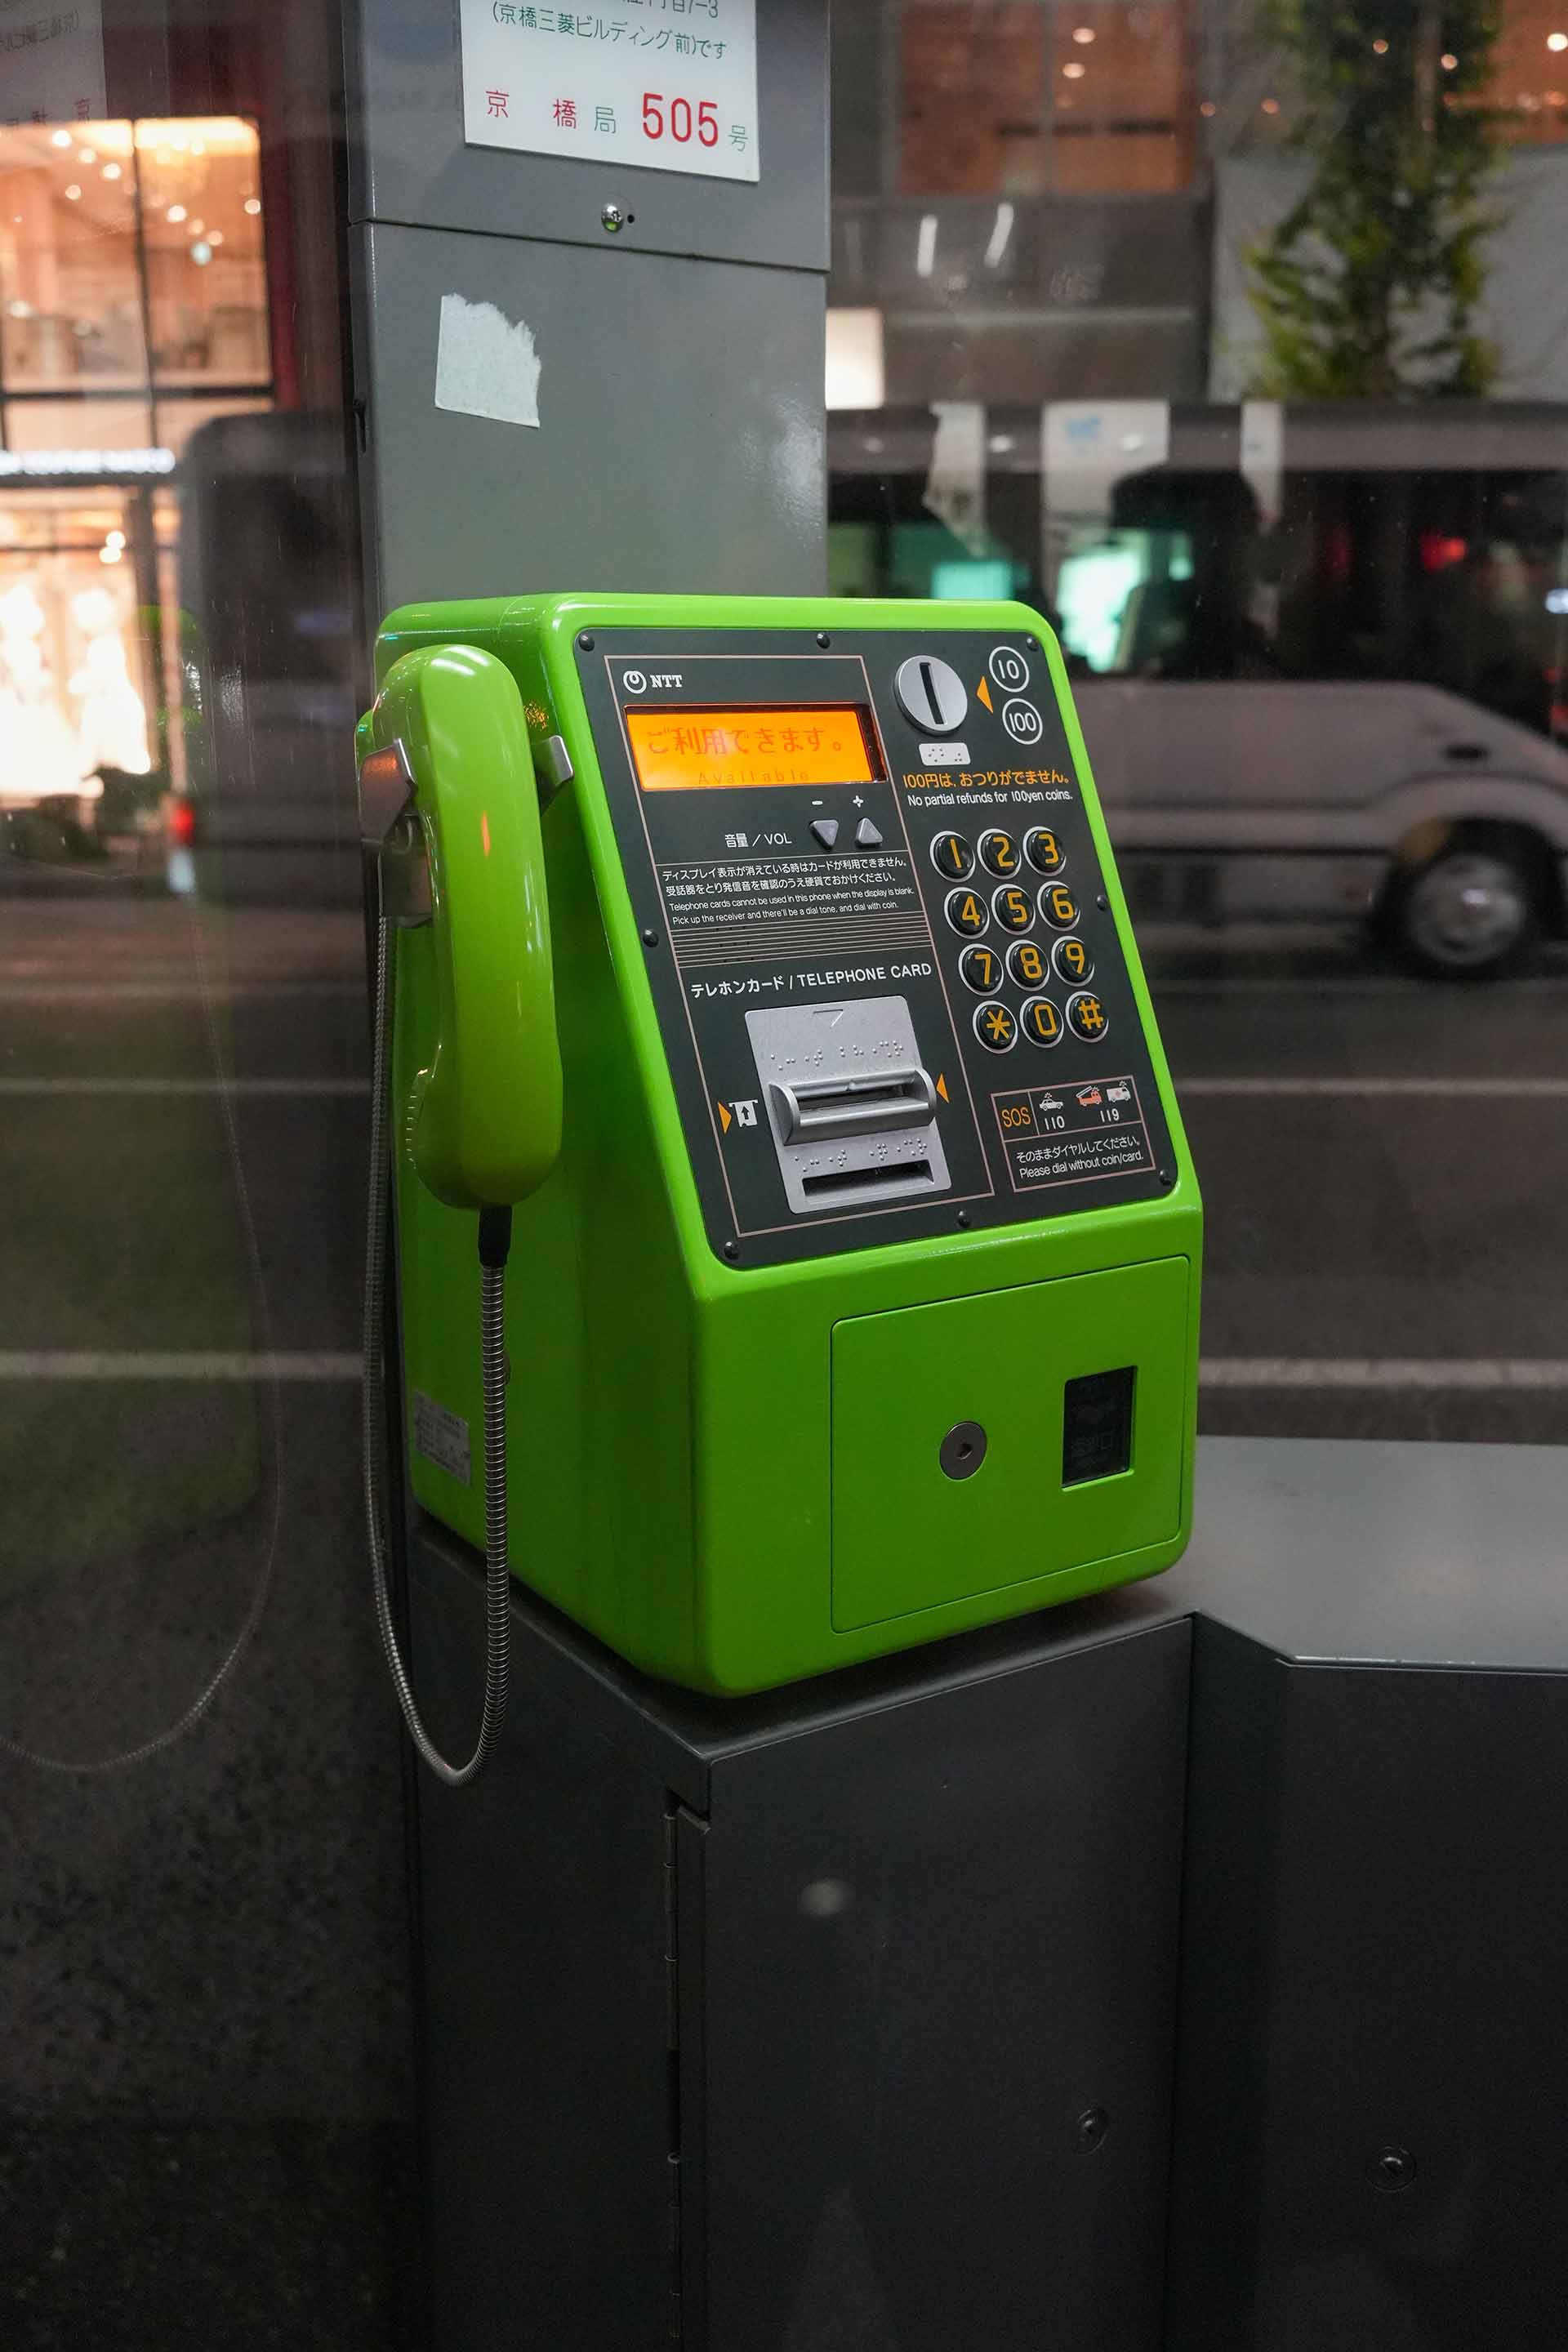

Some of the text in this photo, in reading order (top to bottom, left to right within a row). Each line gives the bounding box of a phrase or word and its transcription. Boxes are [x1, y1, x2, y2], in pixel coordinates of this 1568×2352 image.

[492, 2, 728, 60] (京橋三菱ビルディング前)です
[643, 92, 719, 147] 505
[728, 125, 749, 152] 号
[649, 675, 683, 688] NTT
[997, 659, 1021, 680] 10
[1009, 711, 1036, 733] 100
[647, 727, 841, 755] ご利用できます。
[698, 770, 809, 786] Available
[907, 789, 1073, 808] No partial refunds for 100yen coins.
[724, 833, 749, 848] 音量
[764, 833, 792, 845] VOL
[950, 834, 1058, 868] 1 2 3
[662, 857, 906, 881] ディスプレイ表示が消えている時はカードが利用できません。
[666, 872, 895, 897] 受話器をとり発信音を確認のうえ硬貨でおかけください。
[669, 902, 709, 911] Telephone
[710, 899, 731, 908] cards
[732, 898, 758, 906] cannot
[768, 895, 787, 904] used
[795, 894, 808, 902] this
[808, 893, 831, 902] phone
[851, 890, 863, 898] the
[864, 889, 887, 898] display
[888, 888, 894, 896] is
[894, 887, 915, 895] blank.
[962, 888, 1075, 926] 4 5 6
[672, 916, 689, 925] Pick
[690, 916, 701, 924] up
[702, 915, 715, 923] the
[715, 912, 745, 921] receiver
[747, 911, 761, 920] and
[762, 908, 787, 918] there'll
[788, 908, 798, 916] be
[805, 906, 818, 915] dial
[839, 904, 853, 912] and
[853, 902, 866, 911] dial
[866, 902, 881, 910] with
[882, 901, 899, 909] coin.
[974, 942, 1085, 985] 7 8 9
[691, 975, 784, 998] テレホンカード
[796, 968, 887, 987] TELEPHONE
[891, 964, 931, 978] CARD
[1033, 1004, 1058, 1036] 0
[1001, 1106, 1031, 1129] SOS
[1045, 1108, 1120, 1130] 110 119
[1016, 1136, 1140, 1163] そのままダイヤルしてください。
[1019, 1150, 1144, 1178] Please dial without coin/card.
